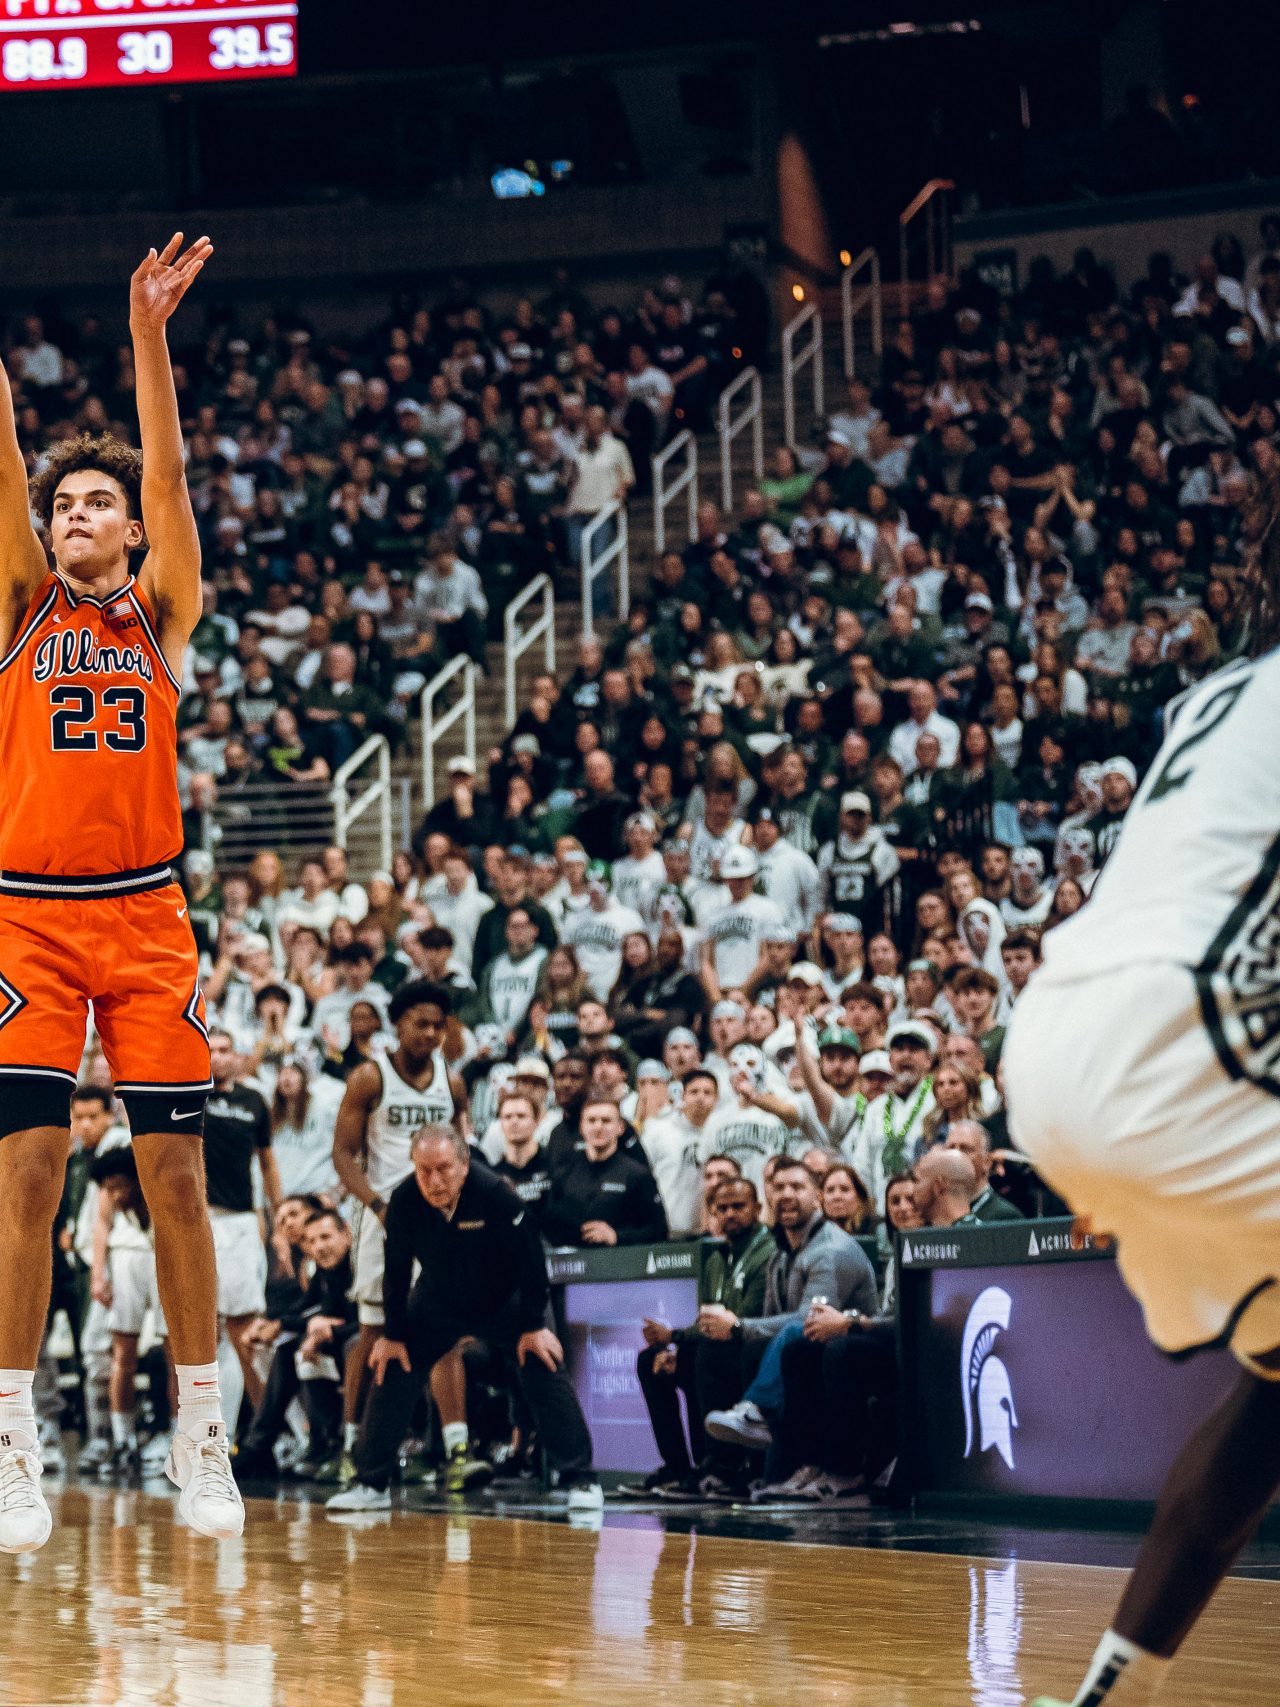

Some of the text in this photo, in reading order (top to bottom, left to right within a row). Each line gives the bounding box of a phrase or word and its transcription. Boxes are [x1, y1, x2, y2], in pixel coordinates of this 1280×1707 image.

[117, 31, 172, 75] 30
[209, 23, 294, 70] 39.5
[33, 627, 153, 684] Illinois
[50, 684, 147, 753] 23
[388, 1104, 447, 1126] STATE
